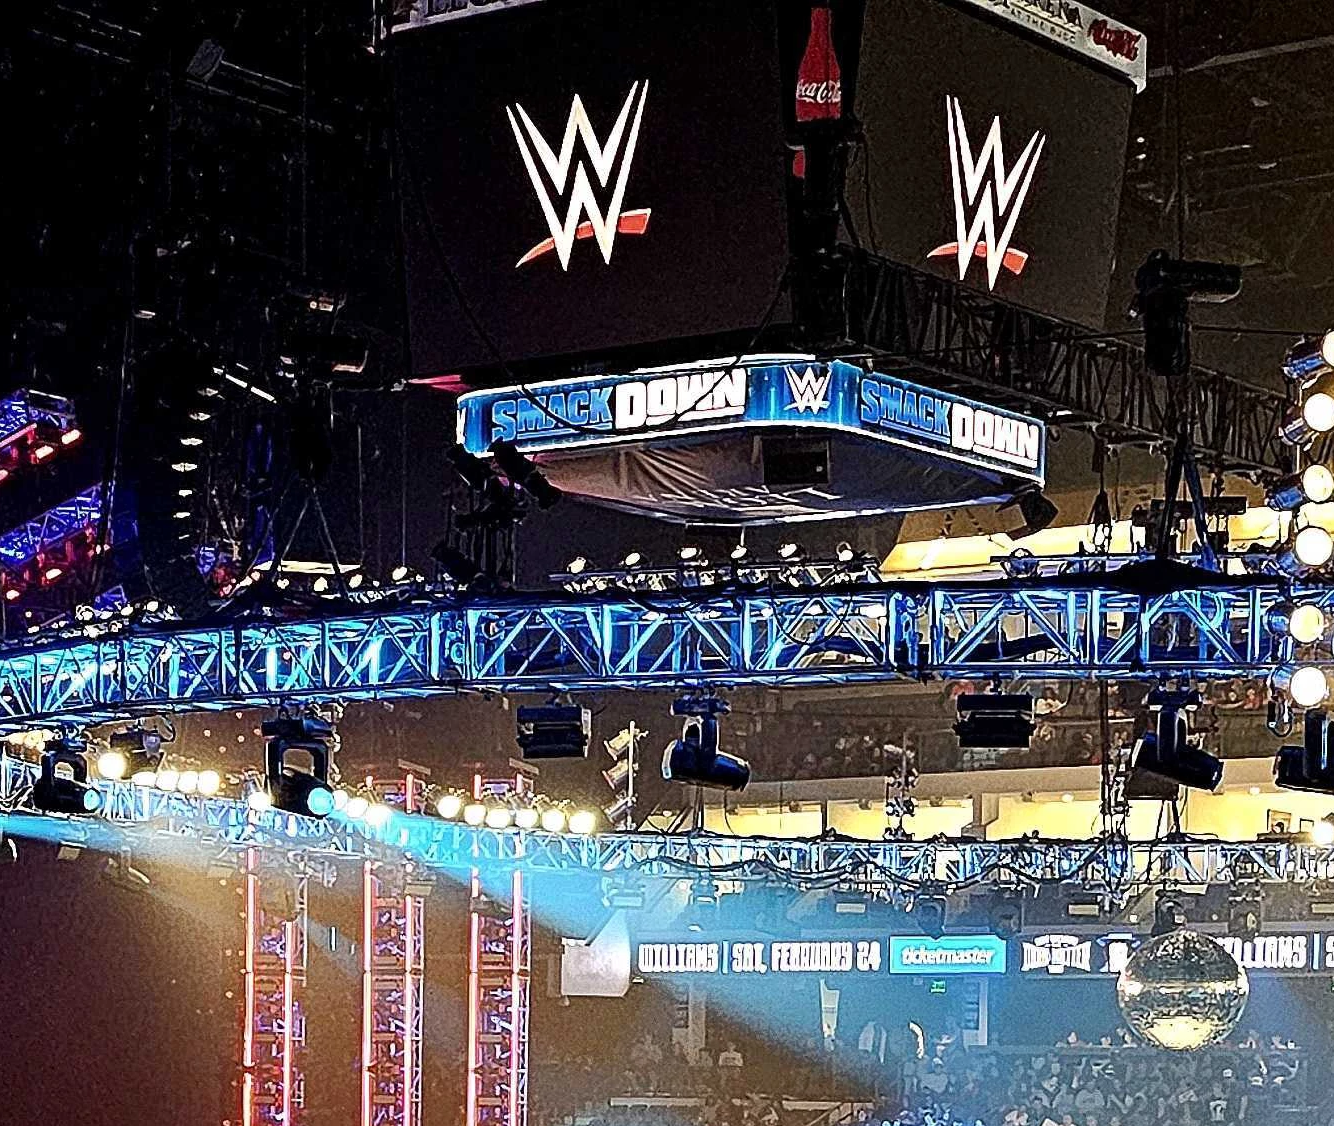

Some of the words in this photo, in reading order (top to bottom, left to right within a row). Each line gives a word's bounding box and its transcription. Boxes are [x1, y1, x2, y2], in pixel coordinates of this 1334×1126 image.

[771, 941, 853, 972] FEBRUARY
[856, 941, 882, 972] 24
[901, 943, 996, 966] ticketmaster
